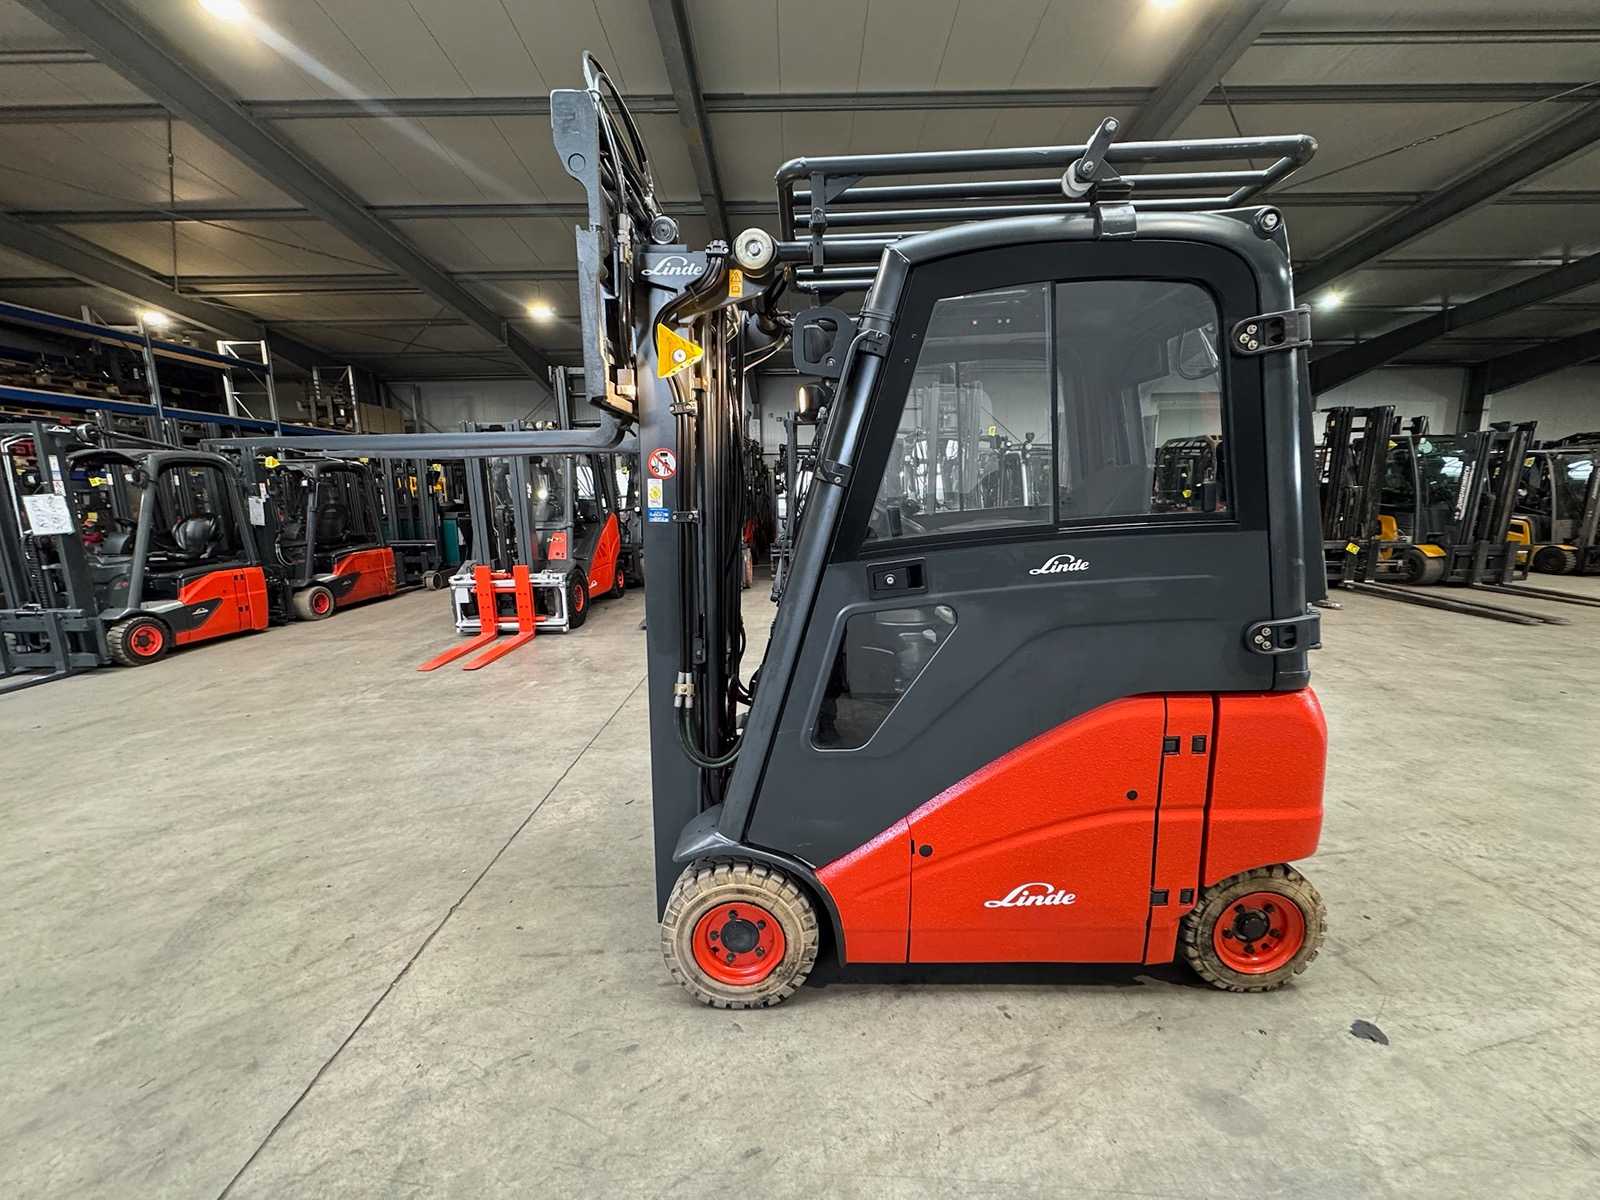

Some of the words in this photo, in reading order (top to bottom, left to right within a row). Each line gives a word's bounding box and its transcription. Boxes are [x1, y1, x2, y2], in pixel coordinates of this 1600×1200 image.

[641, 255, 703, 276] Linde
[1029, 553, 1090, 575] Linde
[983, 882, 1077, 908] Linde
